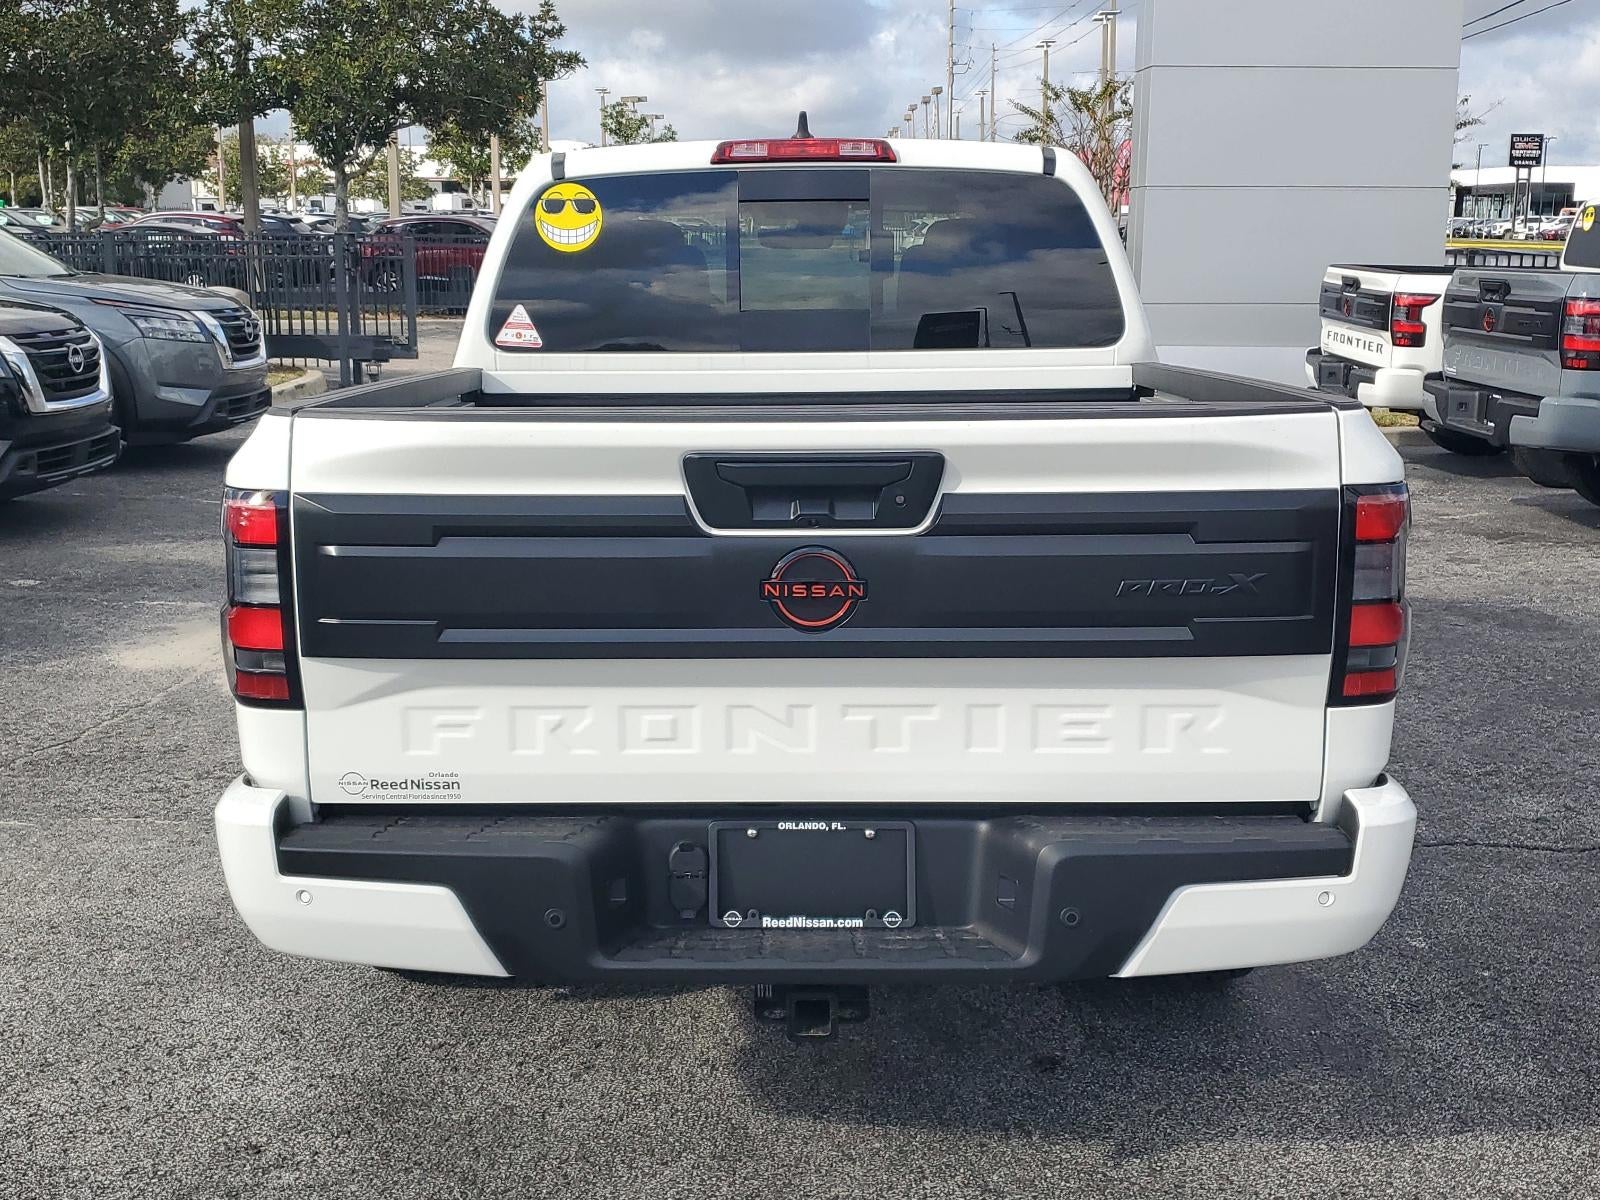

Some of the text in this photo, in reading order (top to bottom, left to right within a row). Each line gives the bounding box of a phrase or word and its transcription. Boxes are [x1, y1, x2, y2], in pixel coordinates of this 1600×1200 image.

[1327, 330, 1384, 354] FRONTIER
[764, 584, 864, 597] NISSAN
[402, 703, 1230, 756] FRONTIER
[370, 778, 461, 790] Reed Nissan
[778, 822, 847, 831] ORLANDO, FL.
[762, 916, 864, 928] ReedNissan.com
